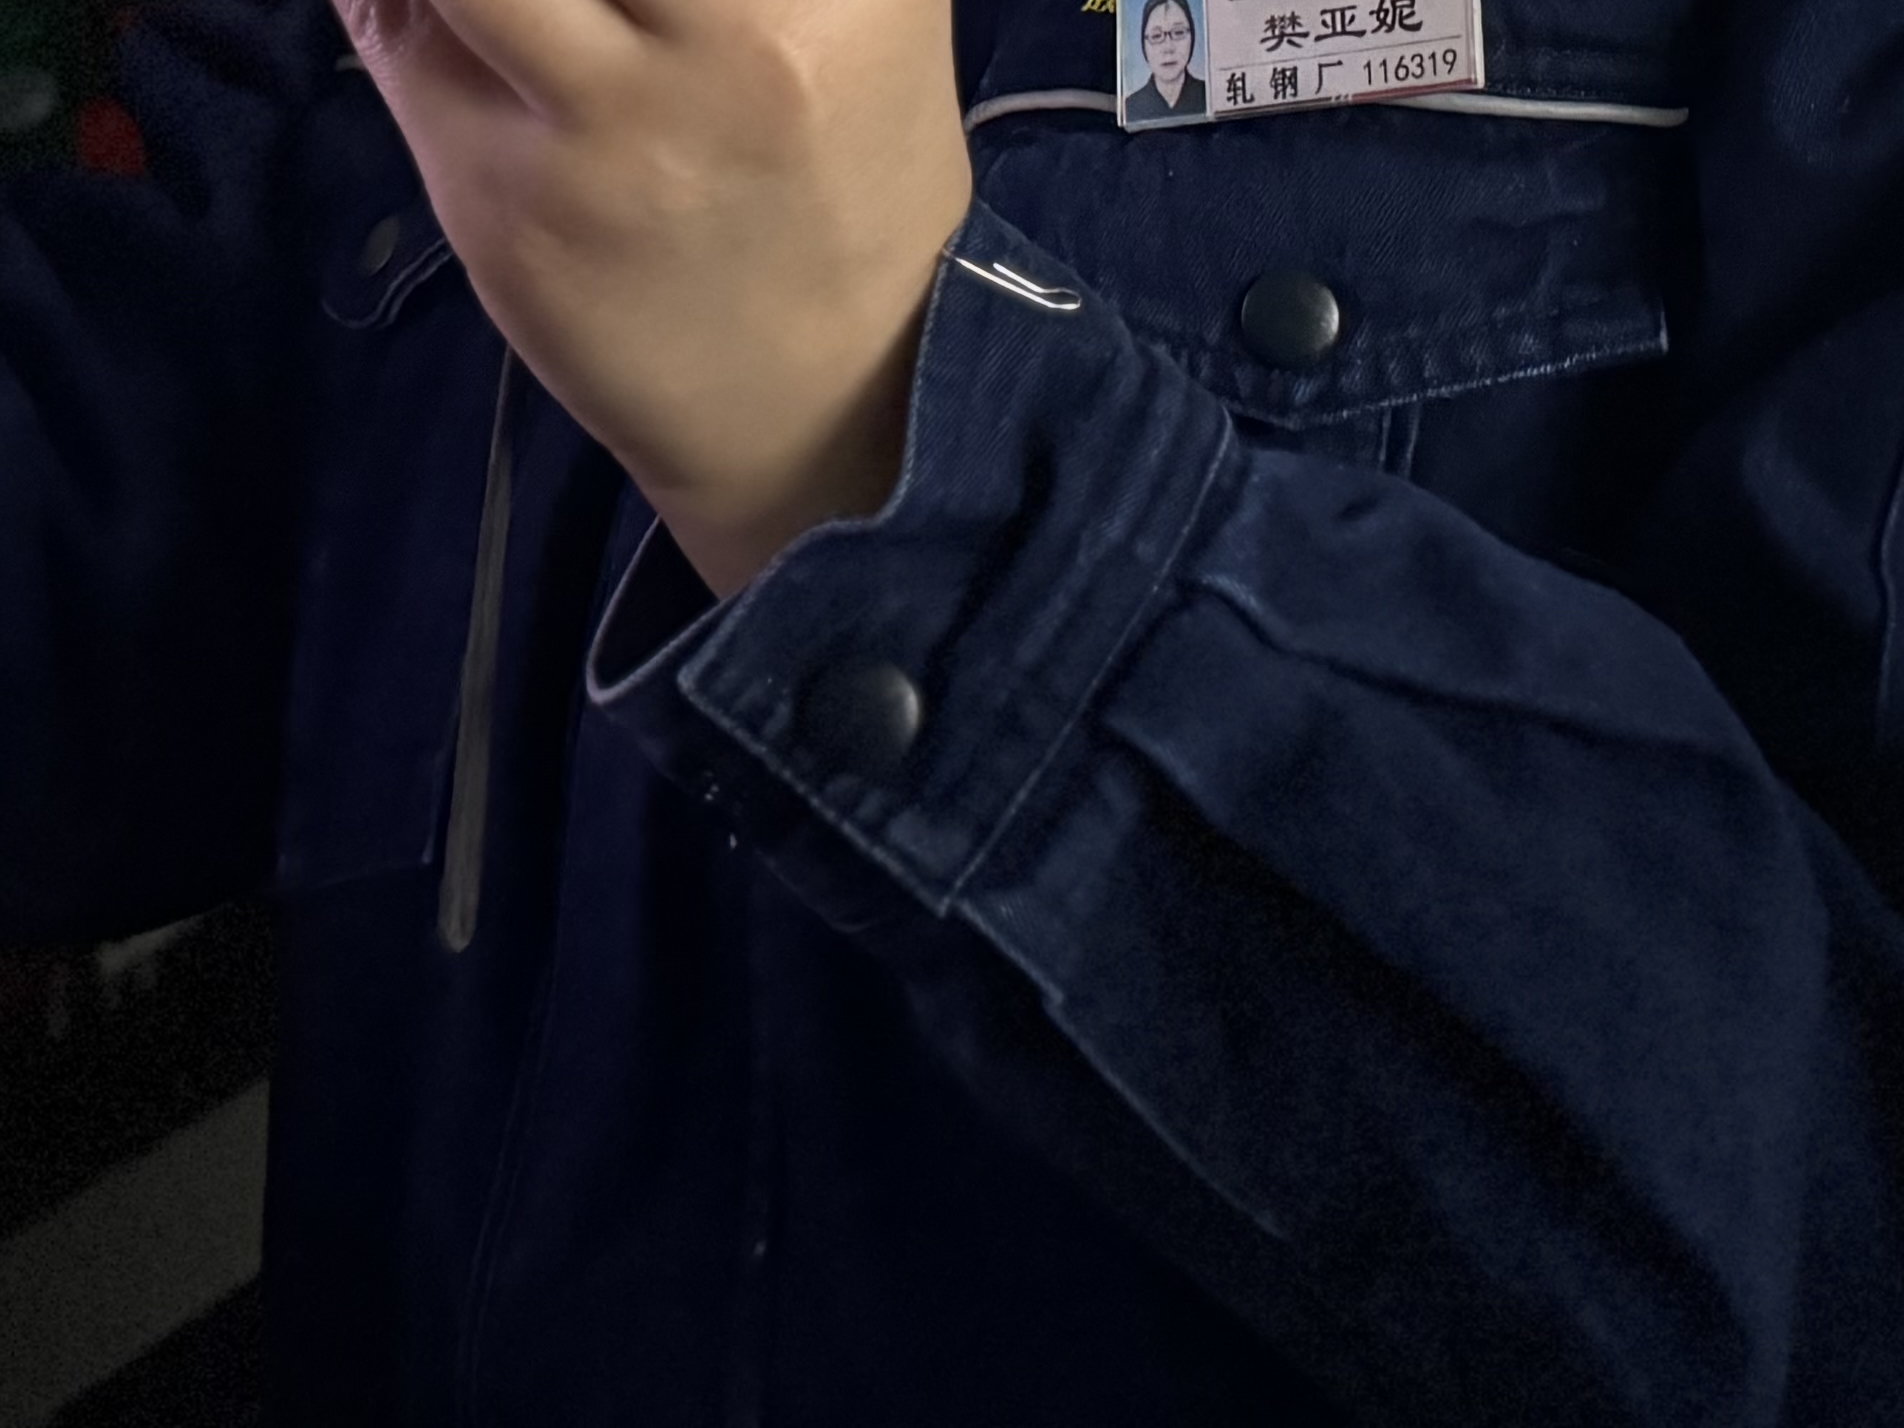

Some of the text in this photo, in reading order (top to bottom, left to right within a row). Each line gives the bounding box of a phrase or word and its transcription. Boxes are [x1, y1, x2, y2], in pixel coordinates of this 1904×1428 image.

[1225, 48, 1459, 107] 轧钢厂 116319
